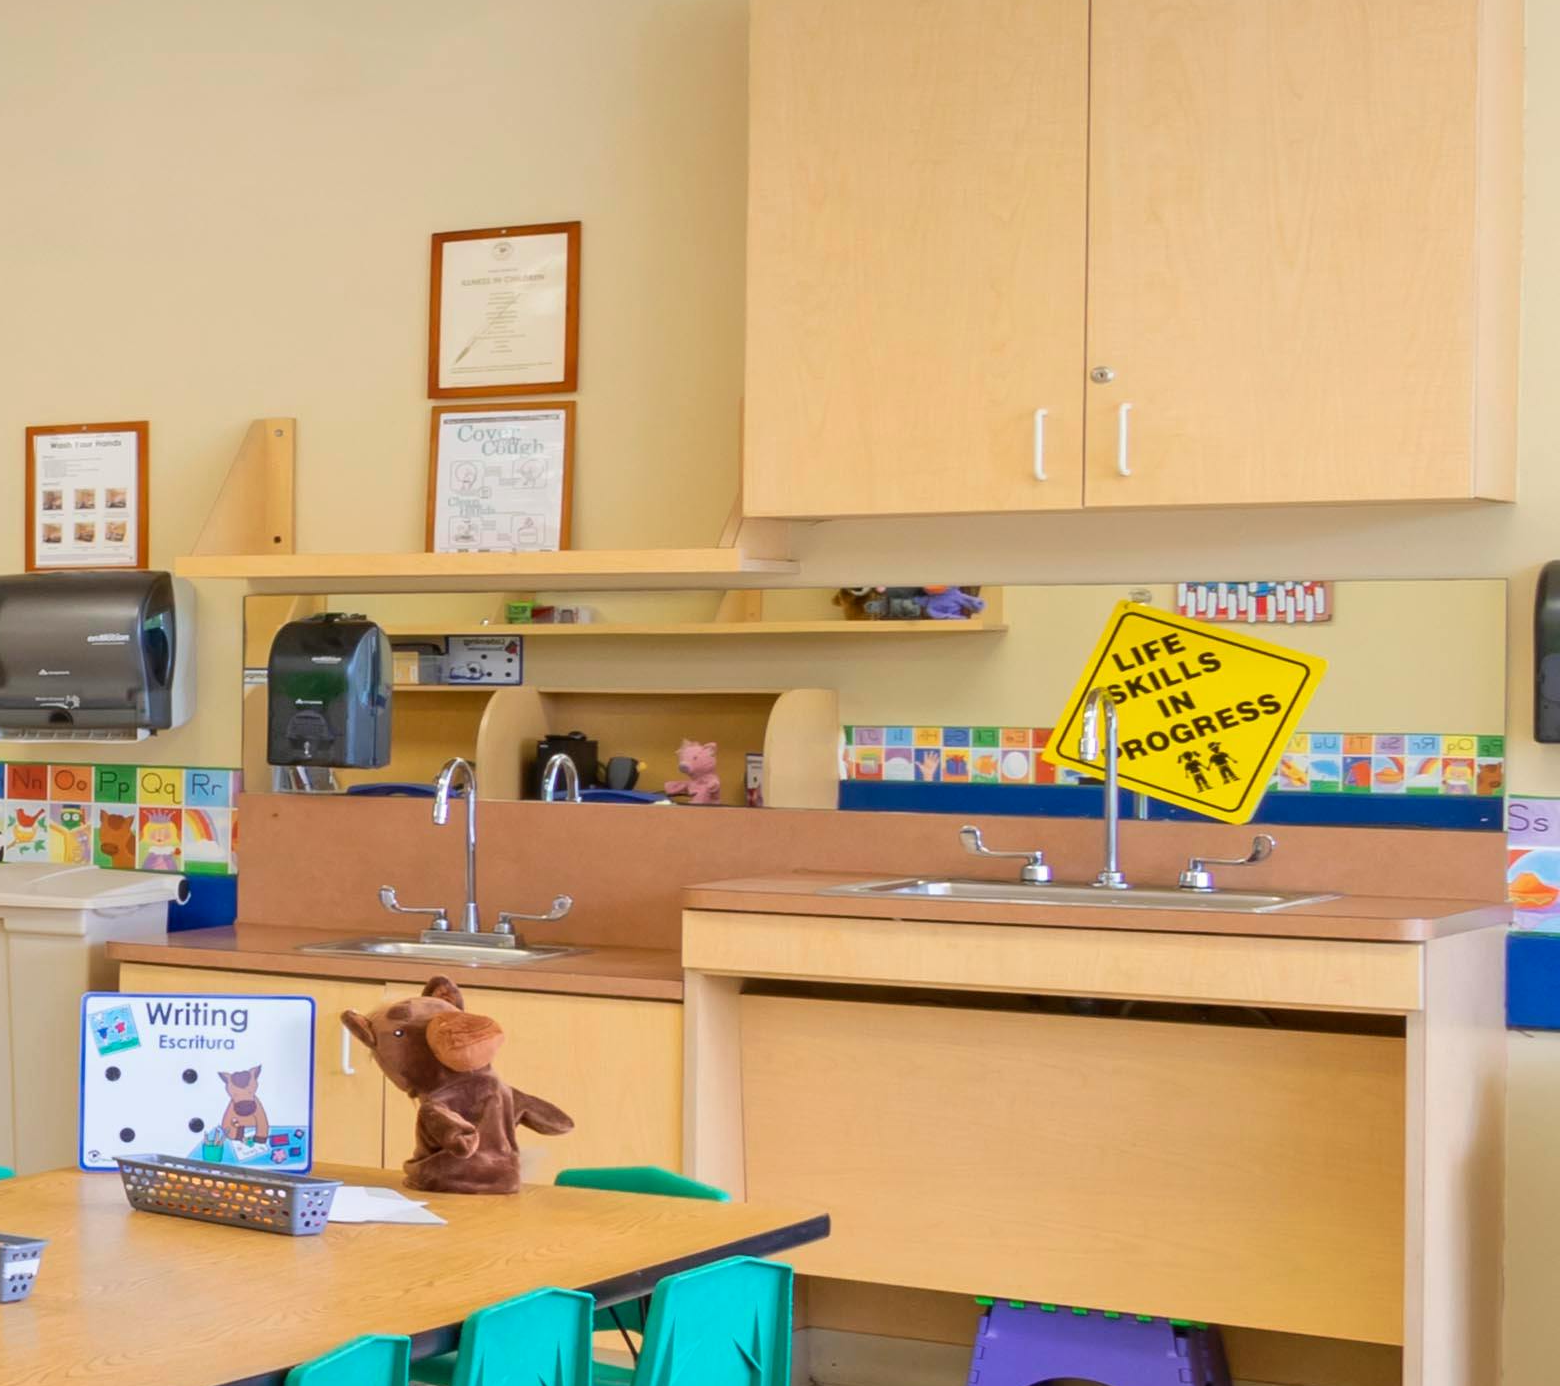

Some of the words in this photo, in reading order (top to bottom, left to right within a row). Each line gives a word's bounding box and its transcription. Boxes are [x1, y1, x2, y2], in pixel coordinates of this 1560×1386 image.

[457, 423, 521, 443] Cover
[481, 438, 545, 457] Cough
[1112, 633, 1187, 673] LIFE
[1106, 652, 1222, 706] SKILLS
[1157, 690, 1195, 718] IN
[12, 768, 42, 790] Nn
[54, 769, 88, 791] Oo
[99, 771, 130, 801] Pp
[140, 771, 181, 805] Qq
[191, 773, 222, 797] Rr
[1506, 803, 1550, 833] Ss
[146, 1002, 250, 1033] Writing
[158, 1034, 236, 1051] Escritura
